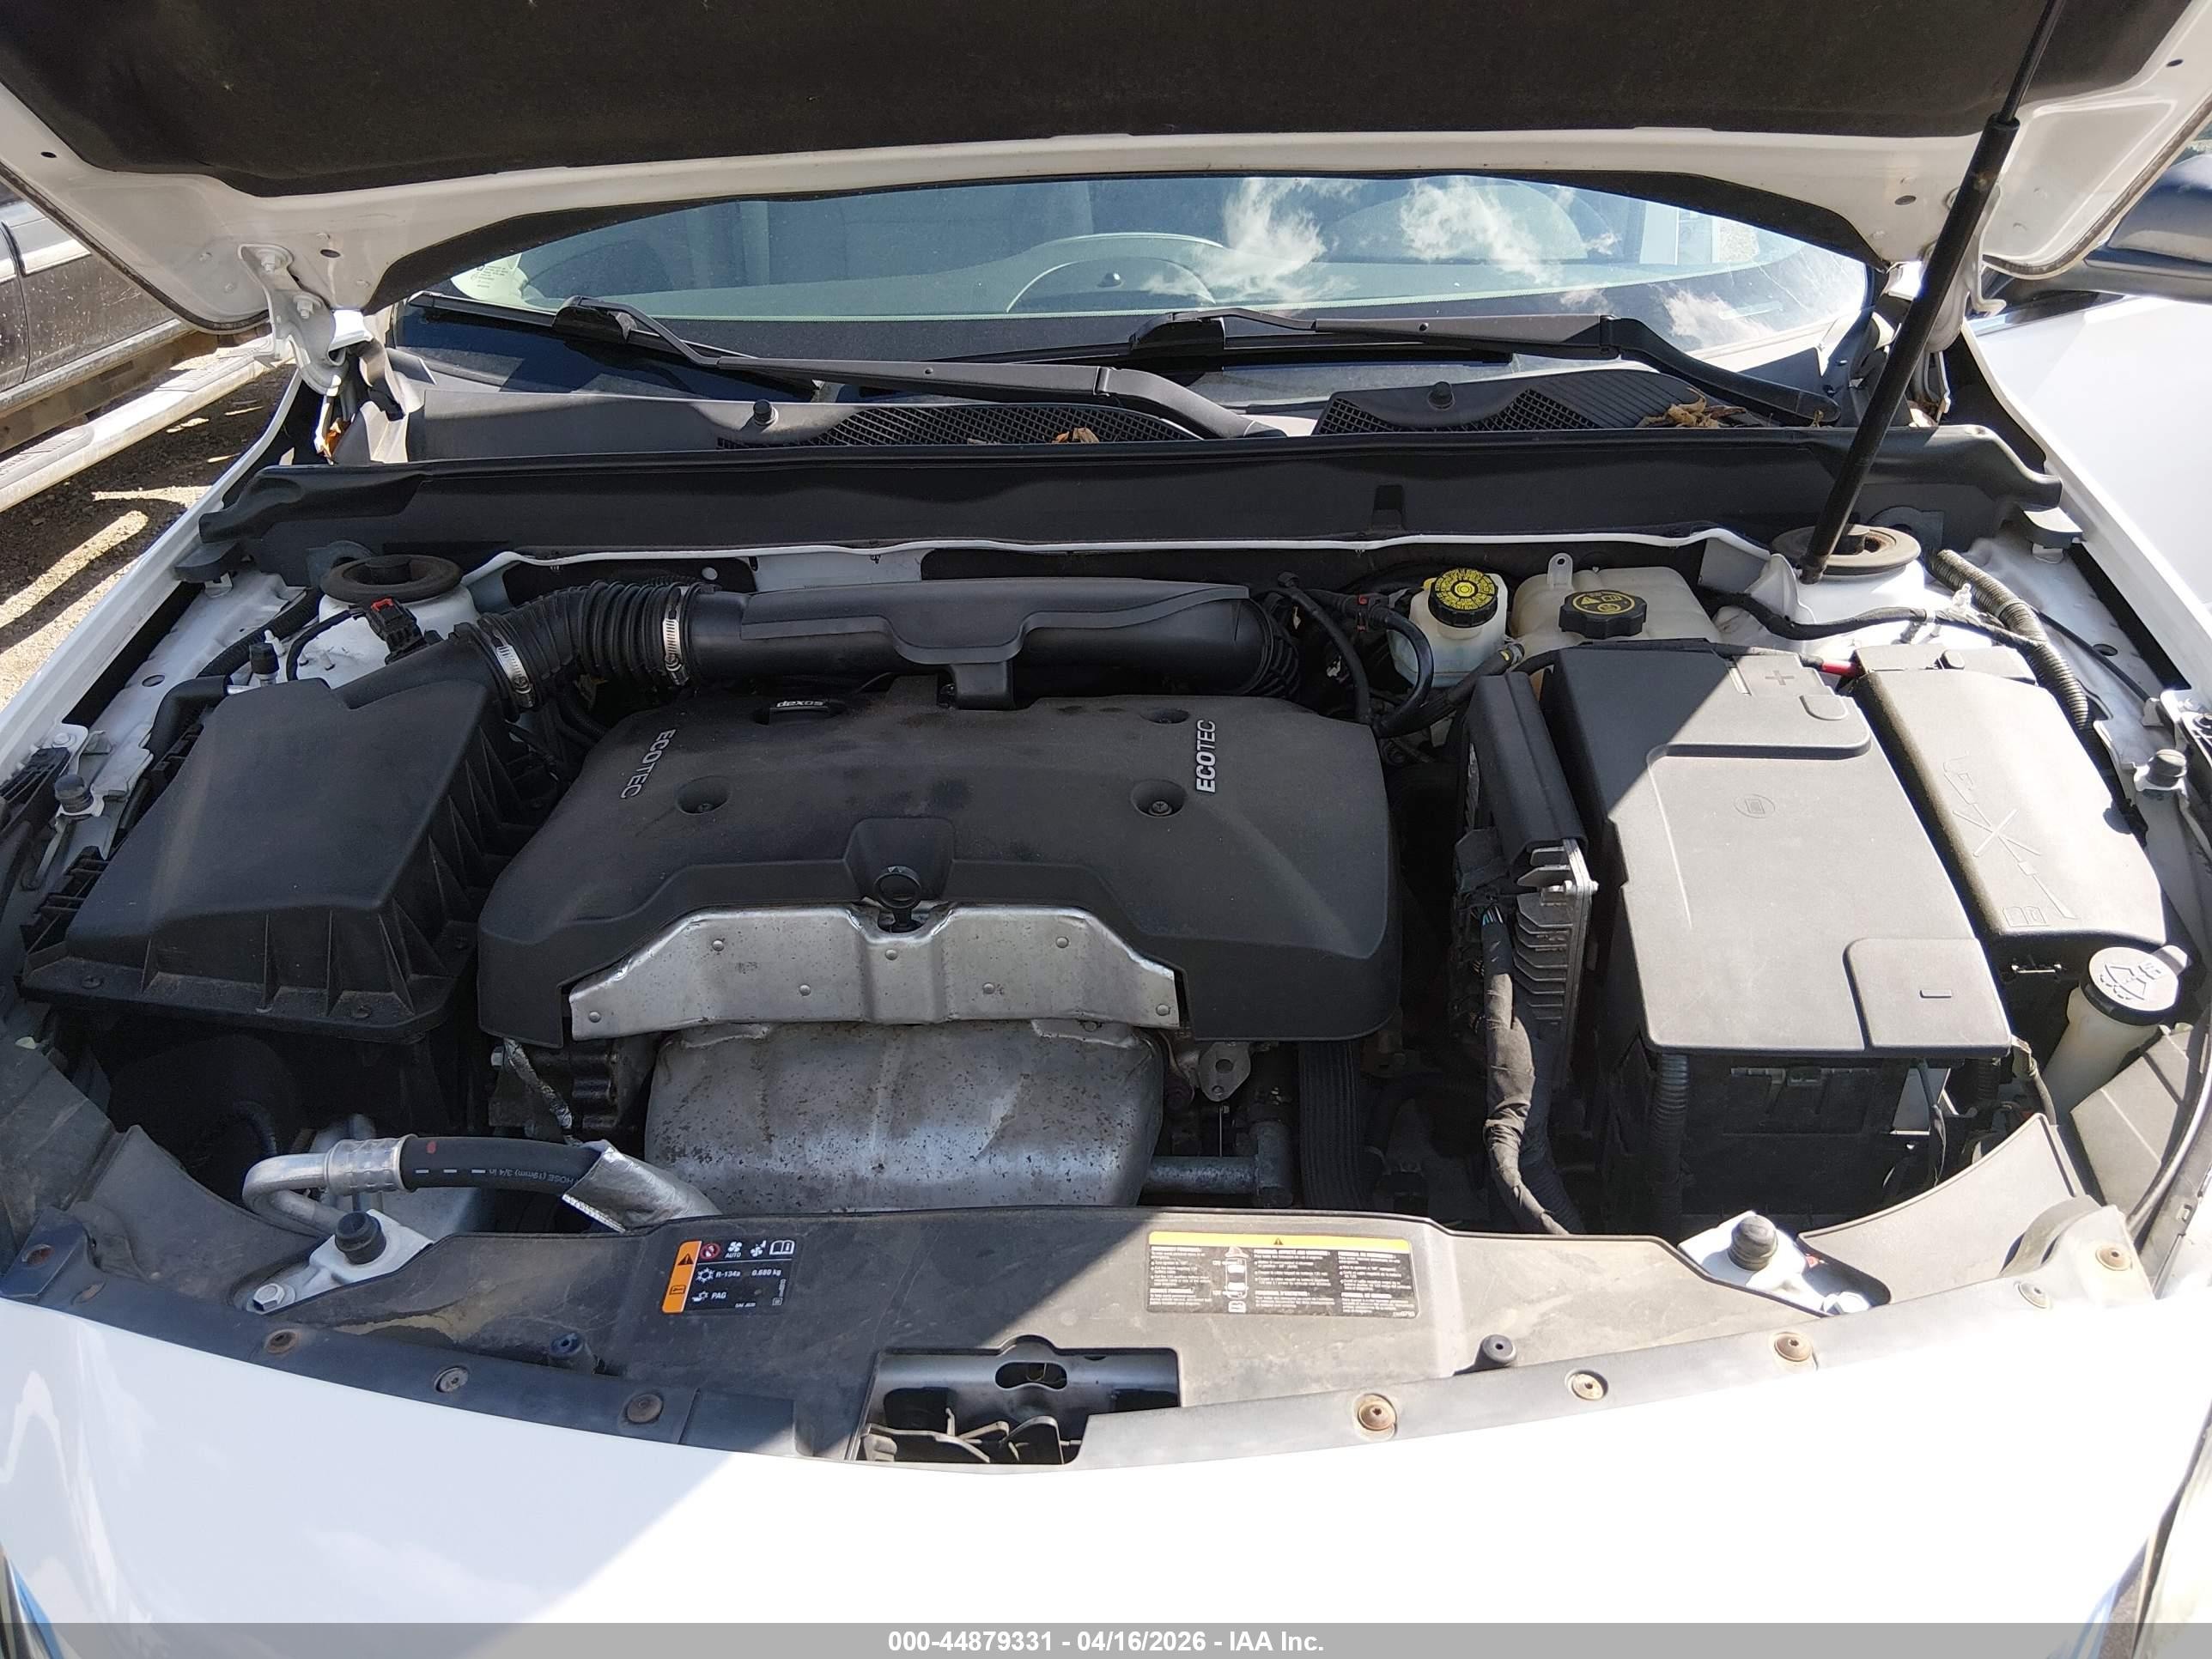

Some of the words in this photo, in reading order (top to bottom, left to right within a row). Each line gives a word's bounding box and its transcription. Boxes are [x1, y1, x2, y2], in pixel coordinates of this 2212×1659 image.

[621, 729, 677, 799] ECOTEC
[1196, 720, 1216, 793] ECOTEC
[548, 1174, 574, 1184] HOSE
